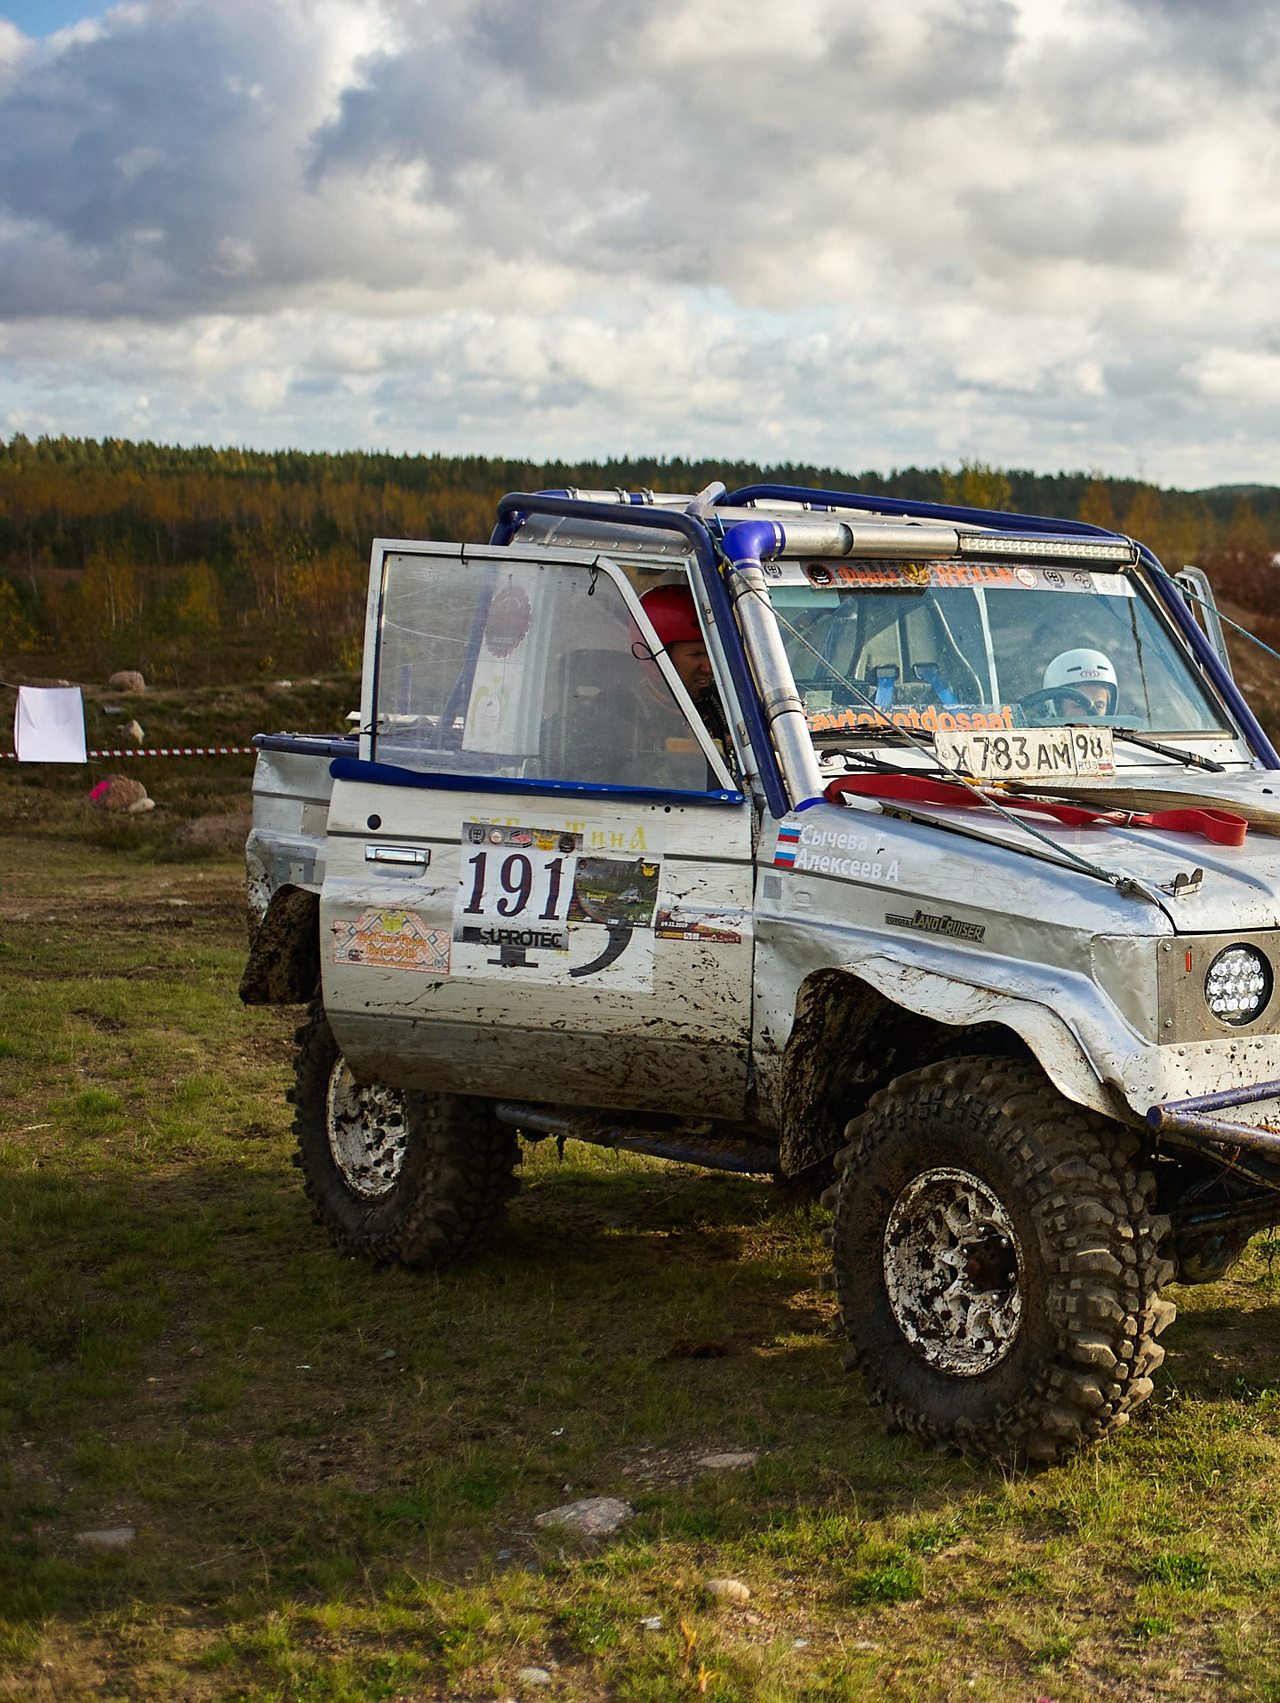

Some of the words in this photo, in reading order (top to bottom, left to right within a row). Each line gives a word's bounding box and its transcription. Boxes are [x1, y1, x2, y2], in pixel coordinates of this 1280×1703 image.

[1078, 761, 1097, 770] RUS
[801, 824, 868, 852] Сычева
[795, 848, 881, 880] Алексеев
[885, 860, 899, 881] А
[463, 851, 564, 921] 191
[480, 928, 562, 948] SUPROTEC
